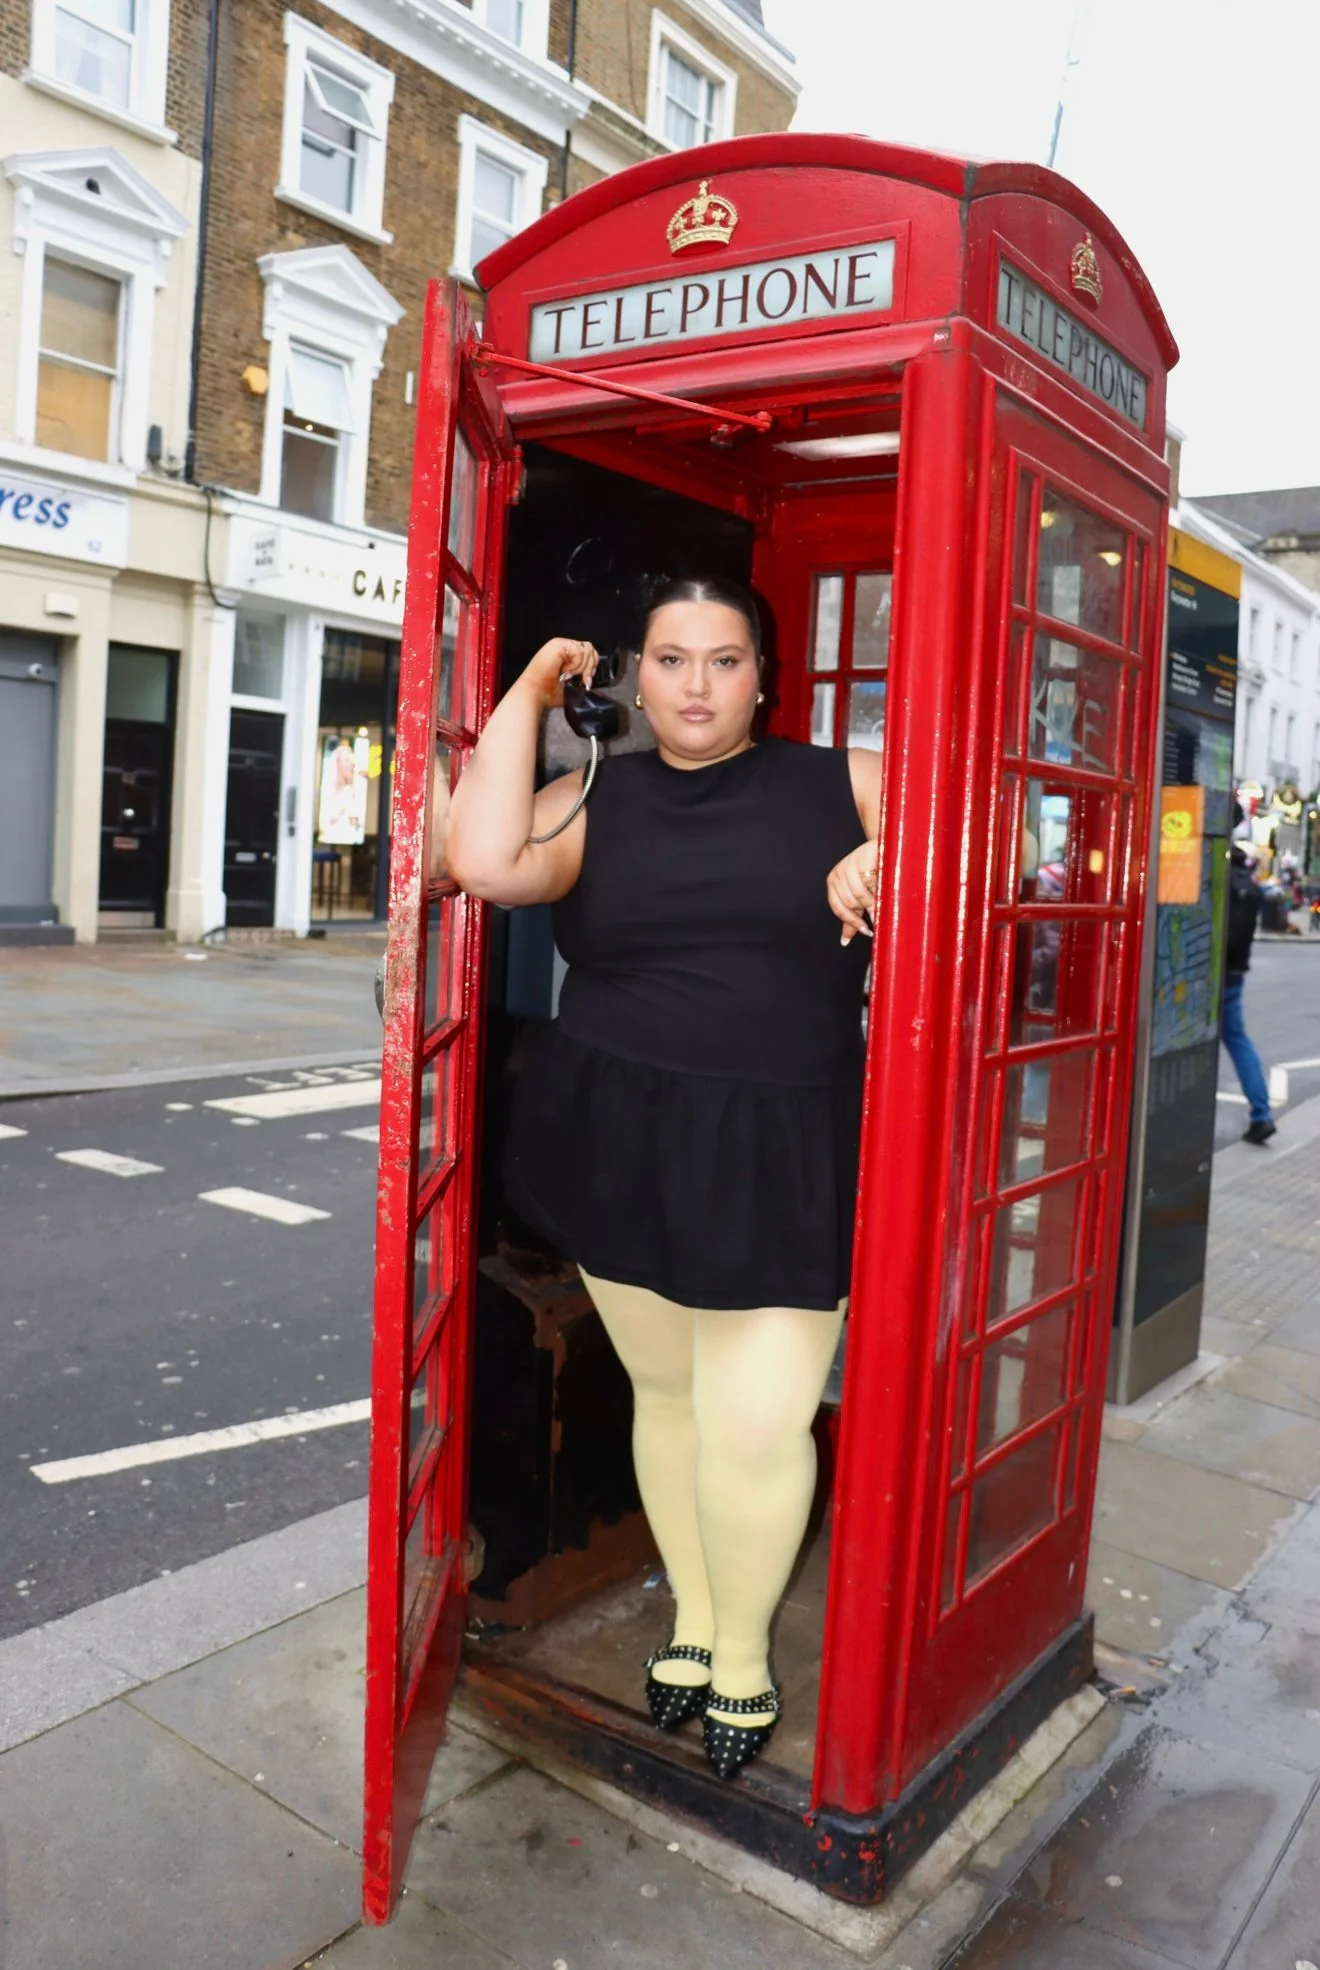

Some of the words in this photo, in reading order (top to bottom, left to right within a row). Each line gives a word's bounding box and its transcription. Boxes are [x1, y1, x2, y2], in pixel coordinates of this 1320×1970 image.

[544, 251, 878, 354] TELEPHONE
[1001, 267, 1141, 423] TELEPHONE
[0, 487, 71, 529] ress
